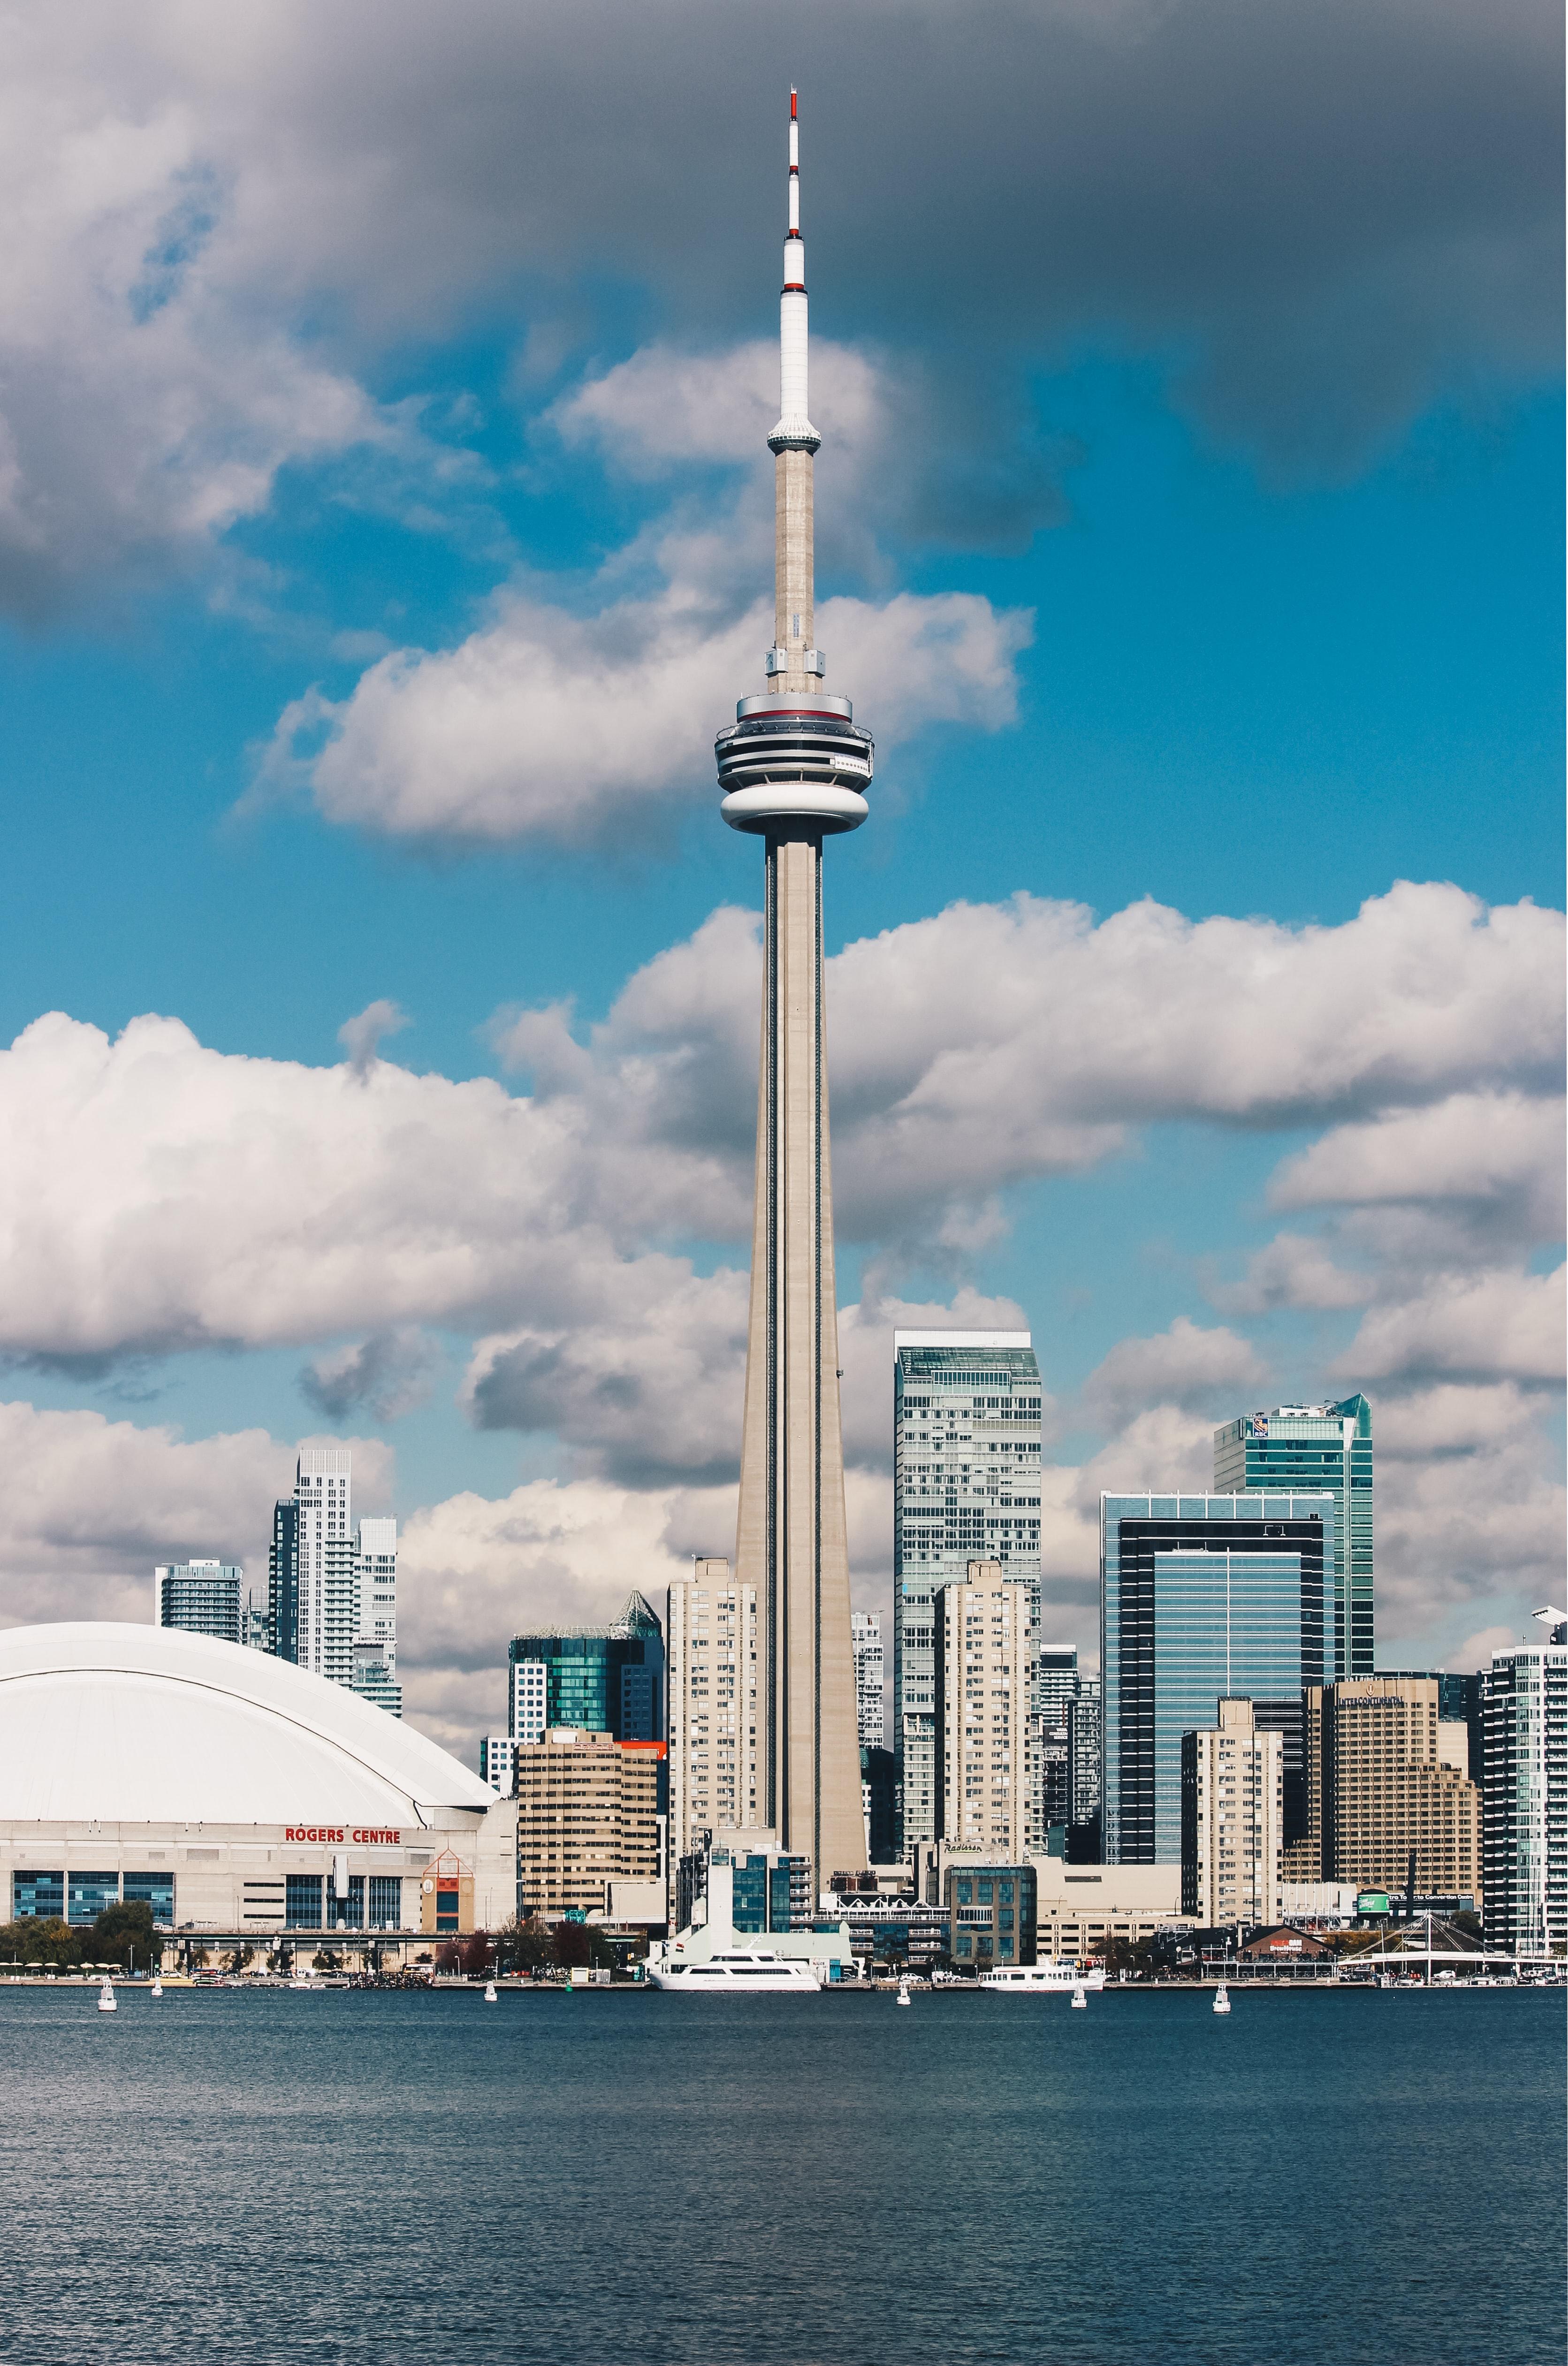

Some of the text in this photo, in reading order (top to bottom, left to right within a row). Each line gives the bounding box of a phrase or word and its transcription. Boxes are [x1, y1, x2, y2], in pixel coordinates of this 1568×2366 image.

[286, 1828, 400, 1844] ROGERS CENTRE
[944, 1844, 982, 1853] Radisson
